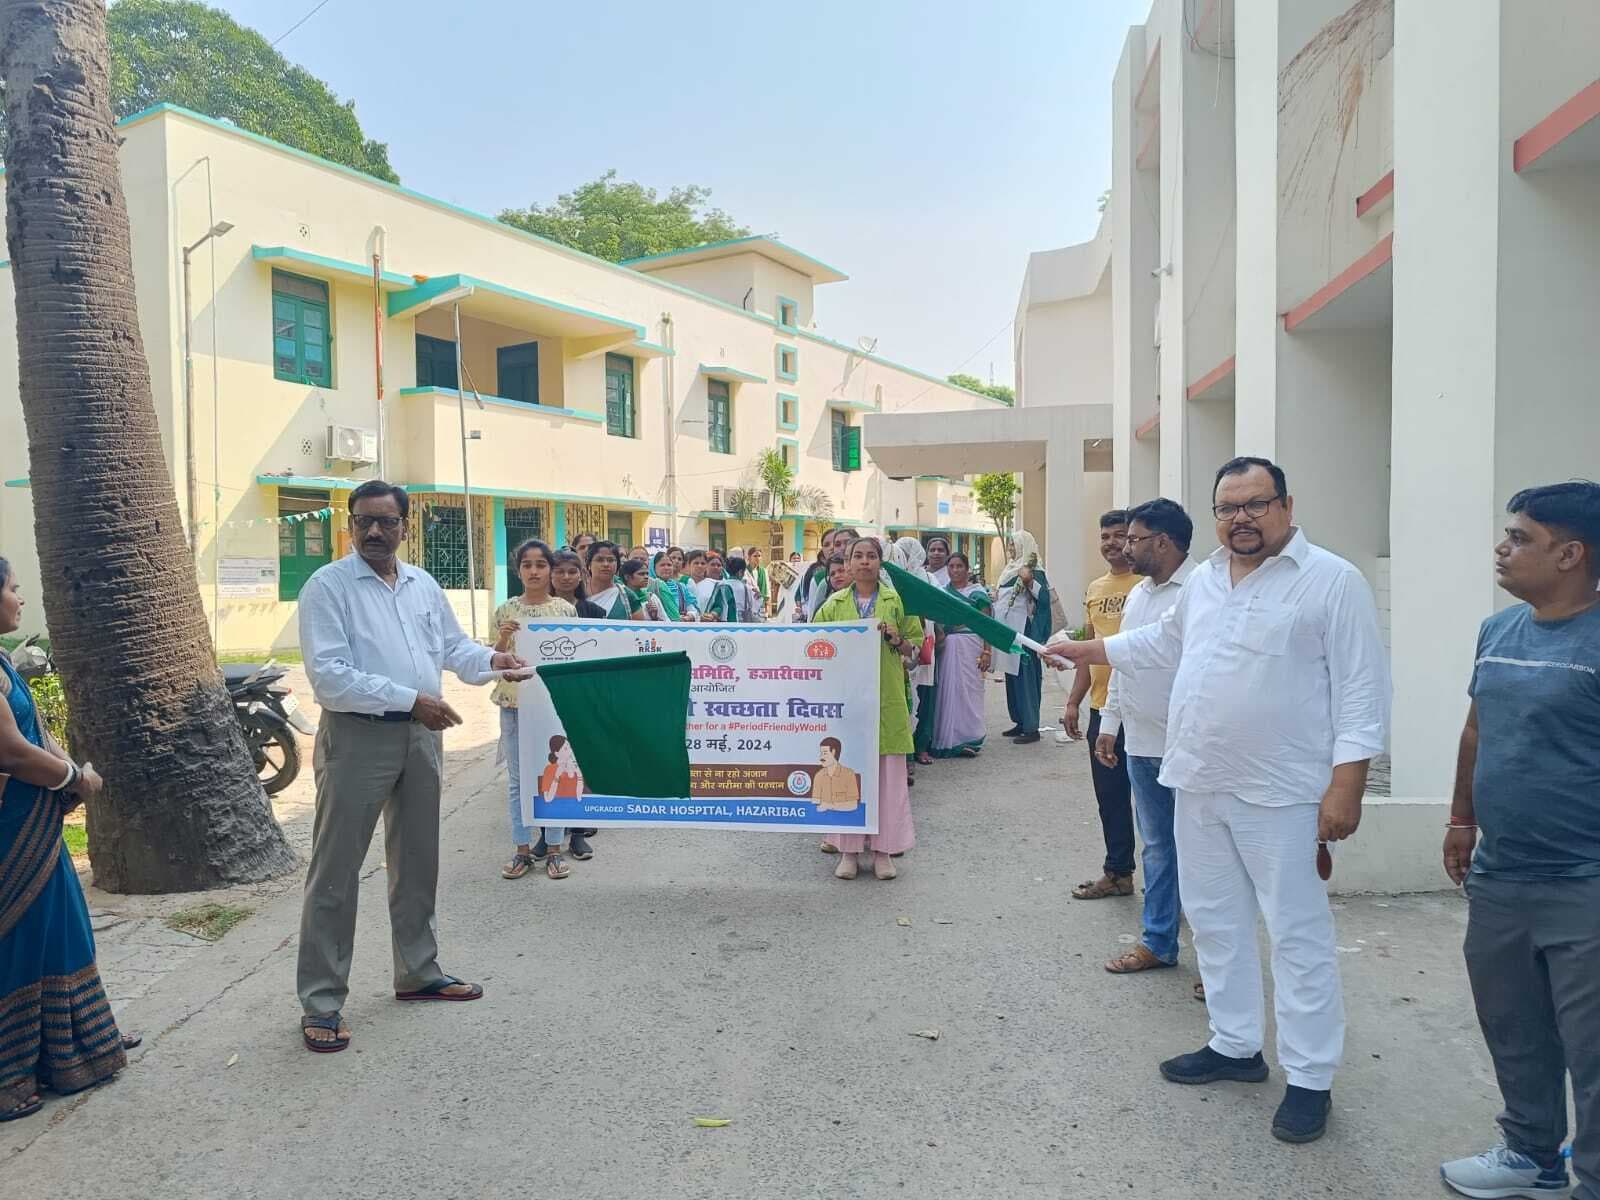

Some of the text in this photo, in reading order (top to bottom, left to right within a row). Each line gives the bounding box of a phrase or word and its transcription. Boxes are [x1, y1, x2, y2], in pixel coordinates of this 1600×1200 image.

[747, 665, 824, 681] हजारीबाग
[703, 701, 780, 717] स्वच्छता
[786, 698, 845, 718] दिवस
[706, 721, 719, 730] for
[728, 722, 828, 733] #PeriodFriendlyWorld
[706, 735, 731, 752] मई,
[737, 740, 772, 750] 2024
[584, 803, 806, 817] UPGRADED SADAR HOSPITAL, HAZARIBAG
